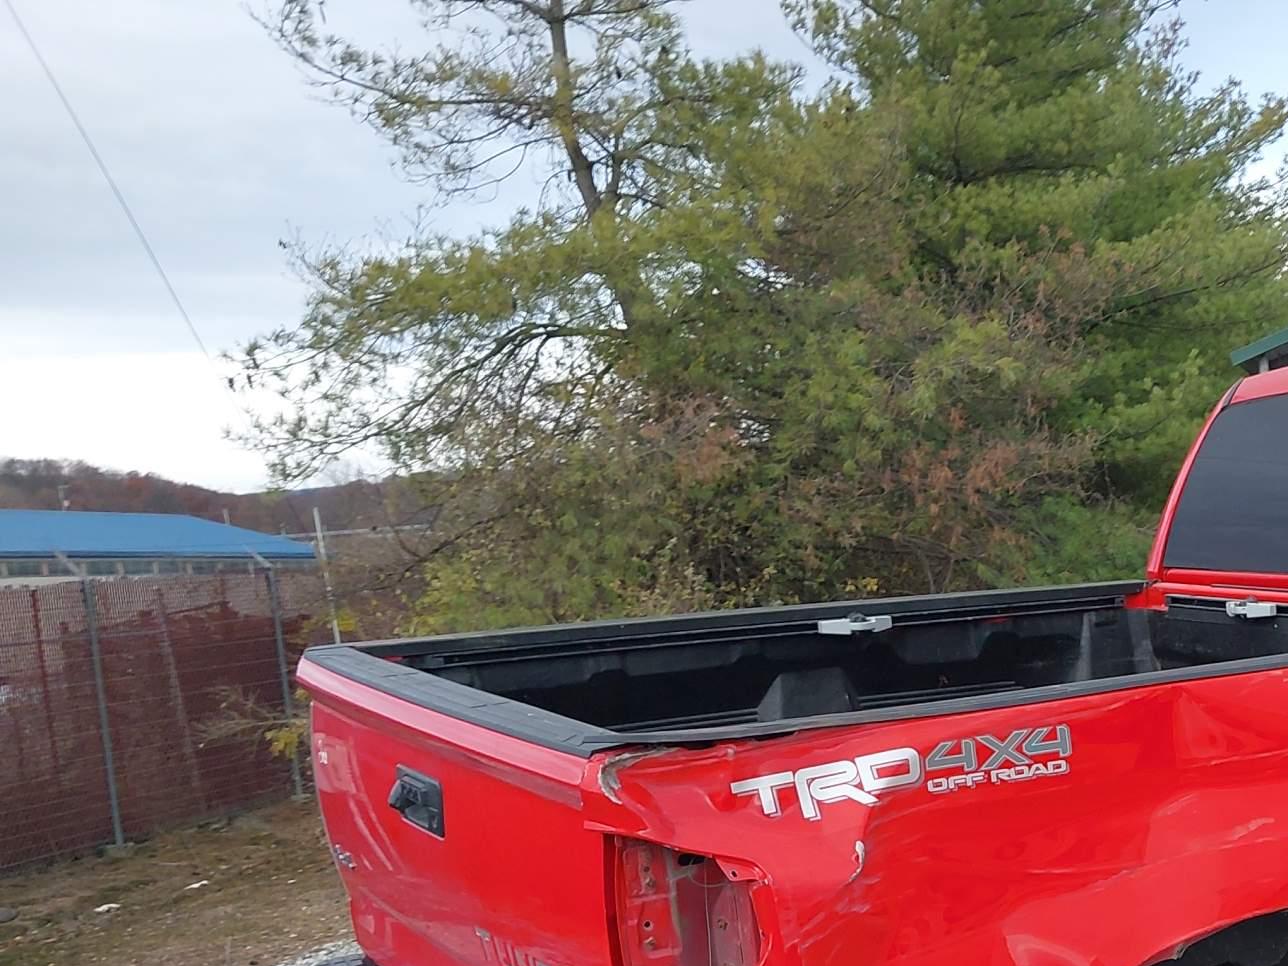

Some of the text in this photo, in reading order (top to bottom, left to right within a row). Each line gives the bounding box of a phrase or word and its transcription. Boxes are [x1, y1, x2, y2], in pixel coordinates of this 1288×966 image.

[730, 747, 924, 820] TRD
[927, 760, 1070, 793] OFF ROAD
